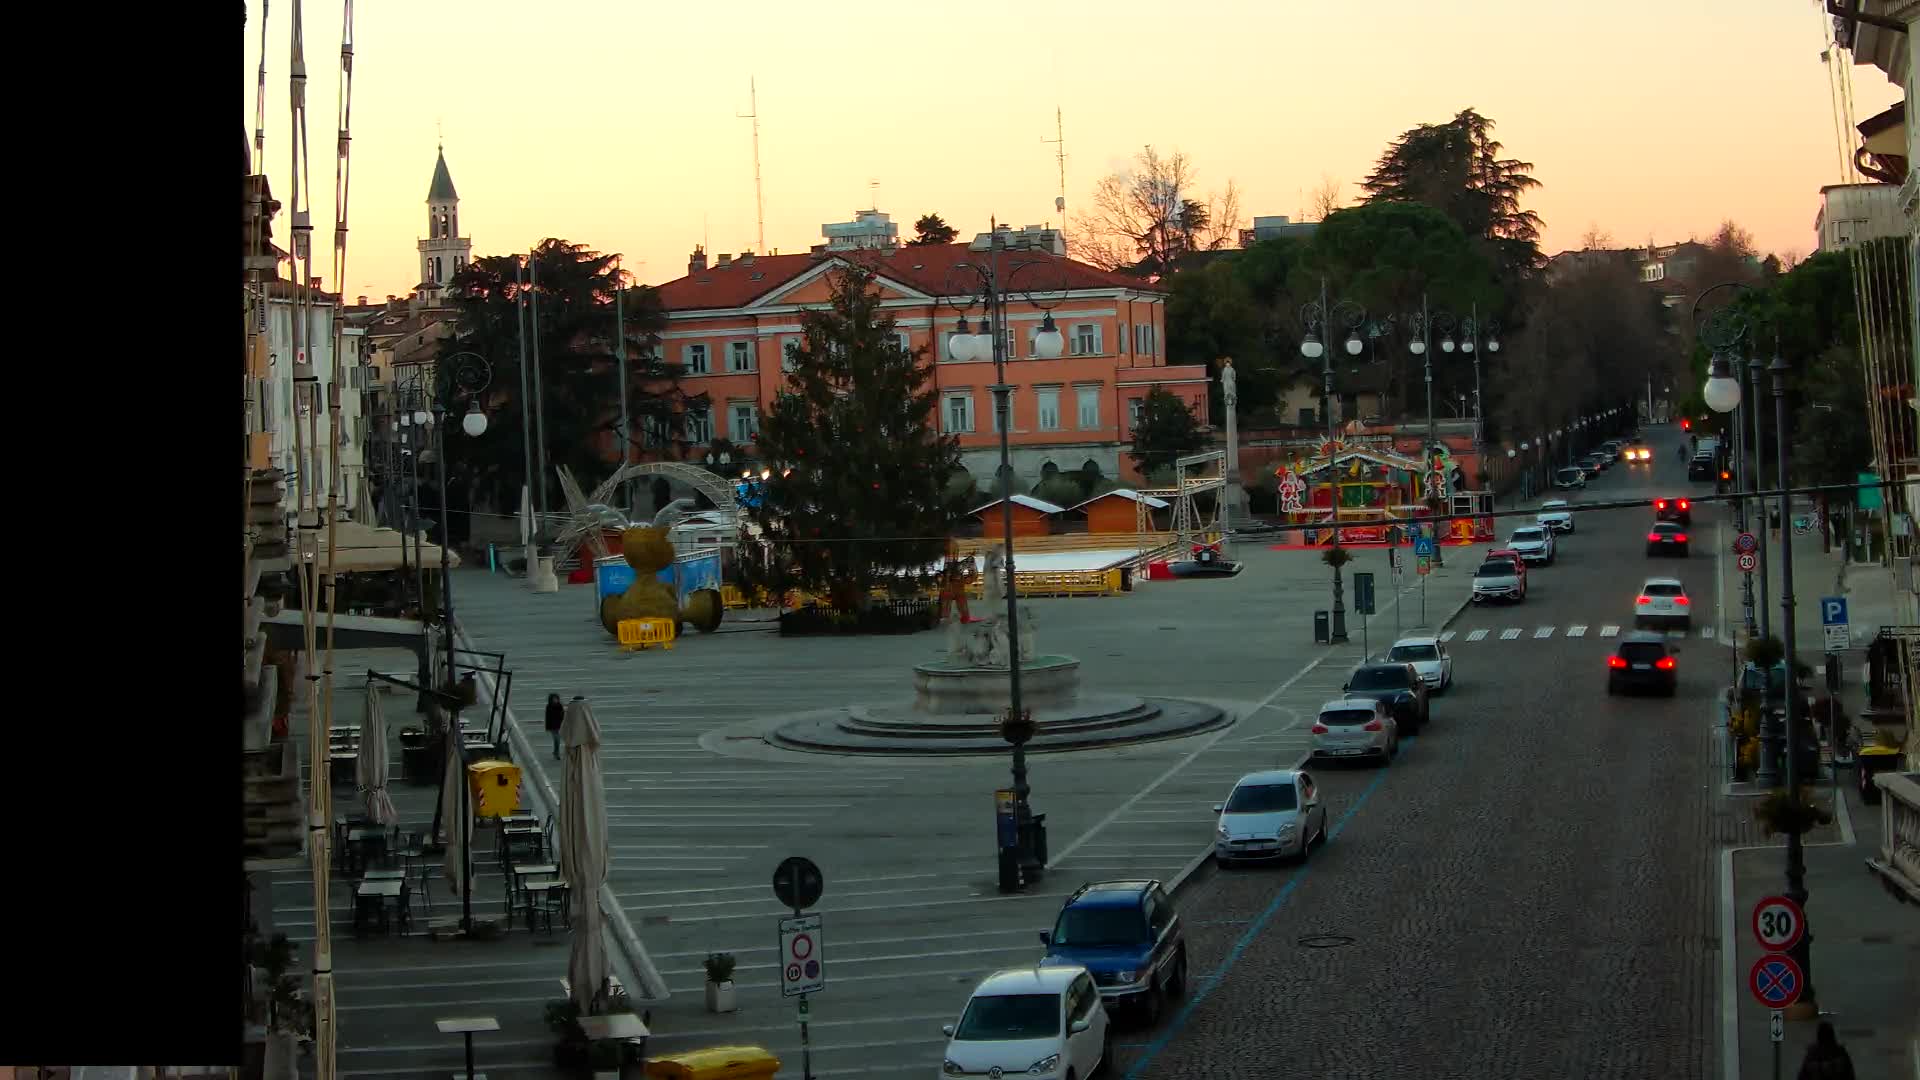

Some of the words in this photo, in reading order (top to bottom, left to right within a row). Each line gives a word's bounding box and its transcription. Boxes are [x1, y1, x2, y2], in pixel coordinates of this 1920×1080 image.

[1742, 557, 1753, 567] 20
[1827, 602, 1842, 621] P
[1762, 911, 1791, 937] 30
